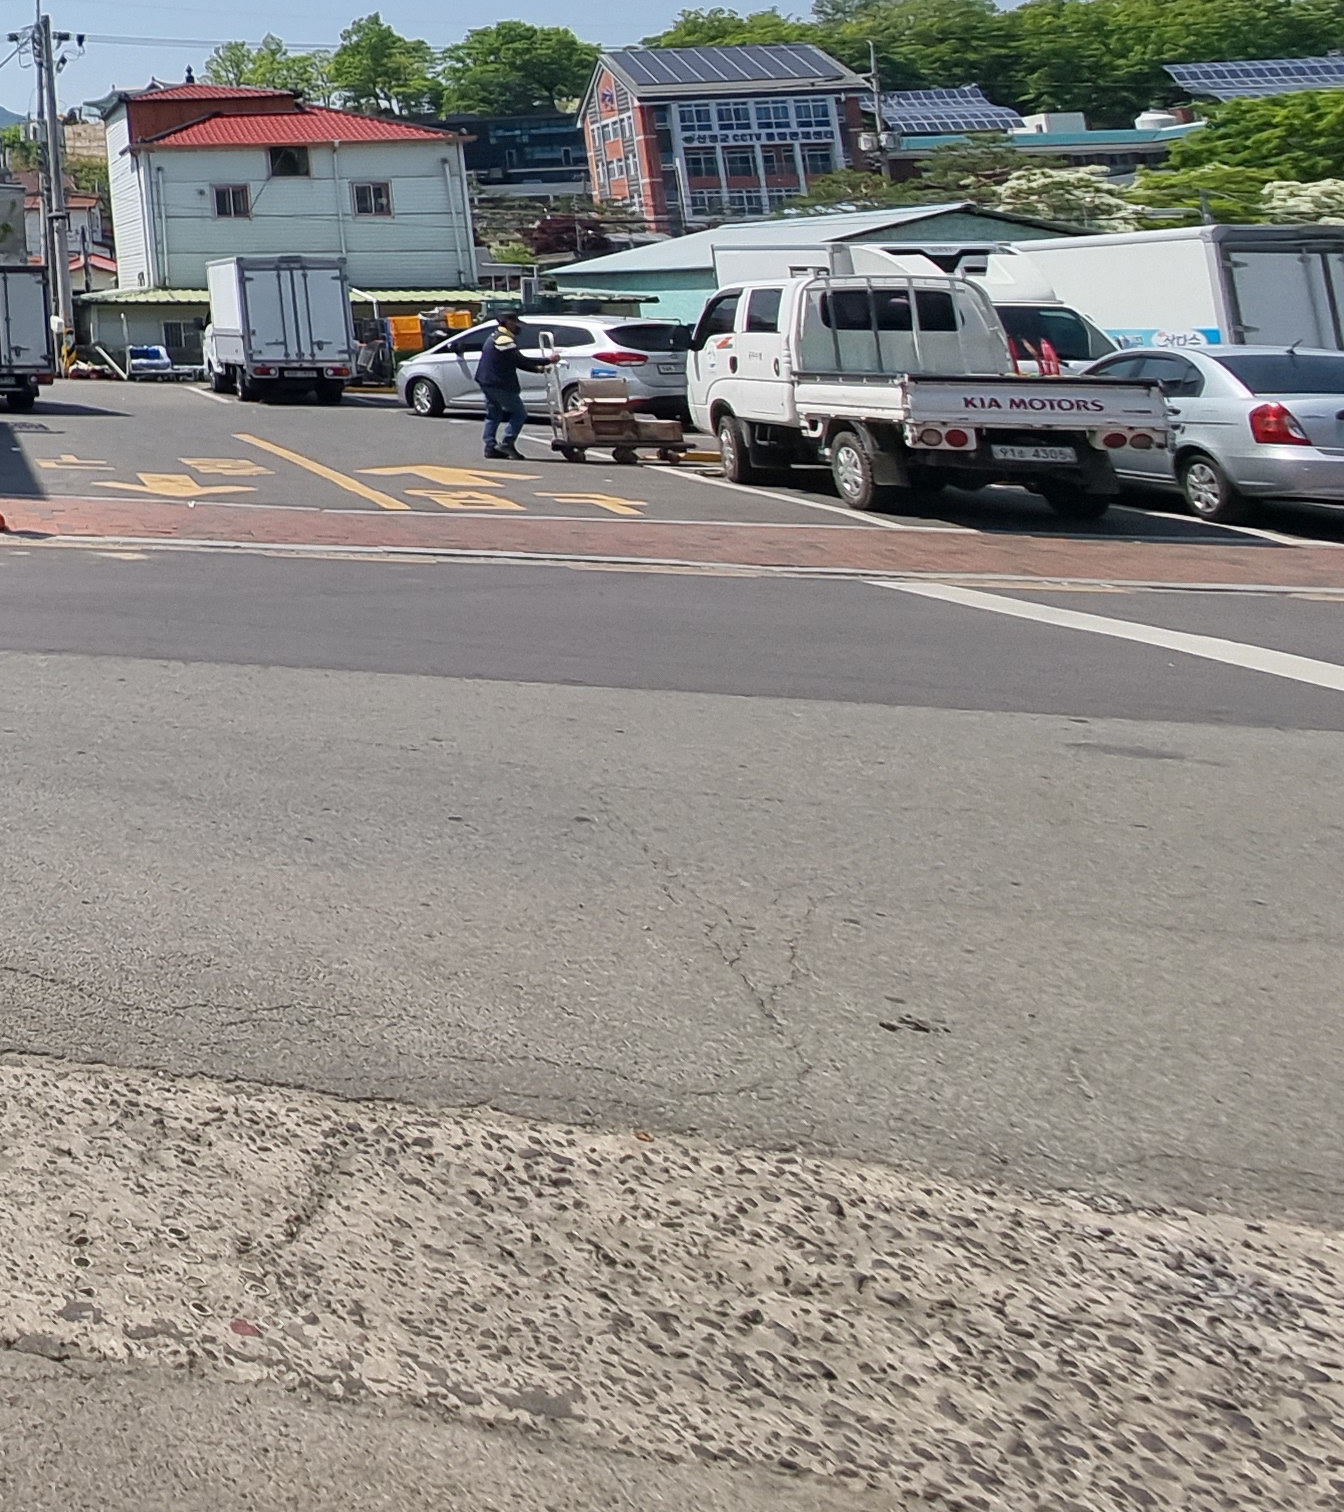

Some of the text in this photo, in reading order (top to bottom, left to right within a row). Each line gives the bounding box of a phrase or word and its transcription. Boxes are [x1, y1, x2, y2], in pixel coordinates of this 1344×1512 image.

[732, 132, 762, 143] CCTV
[962, 396, 1106, 412] KIA MOTORS
[403, 488, 649, 516] 입구
